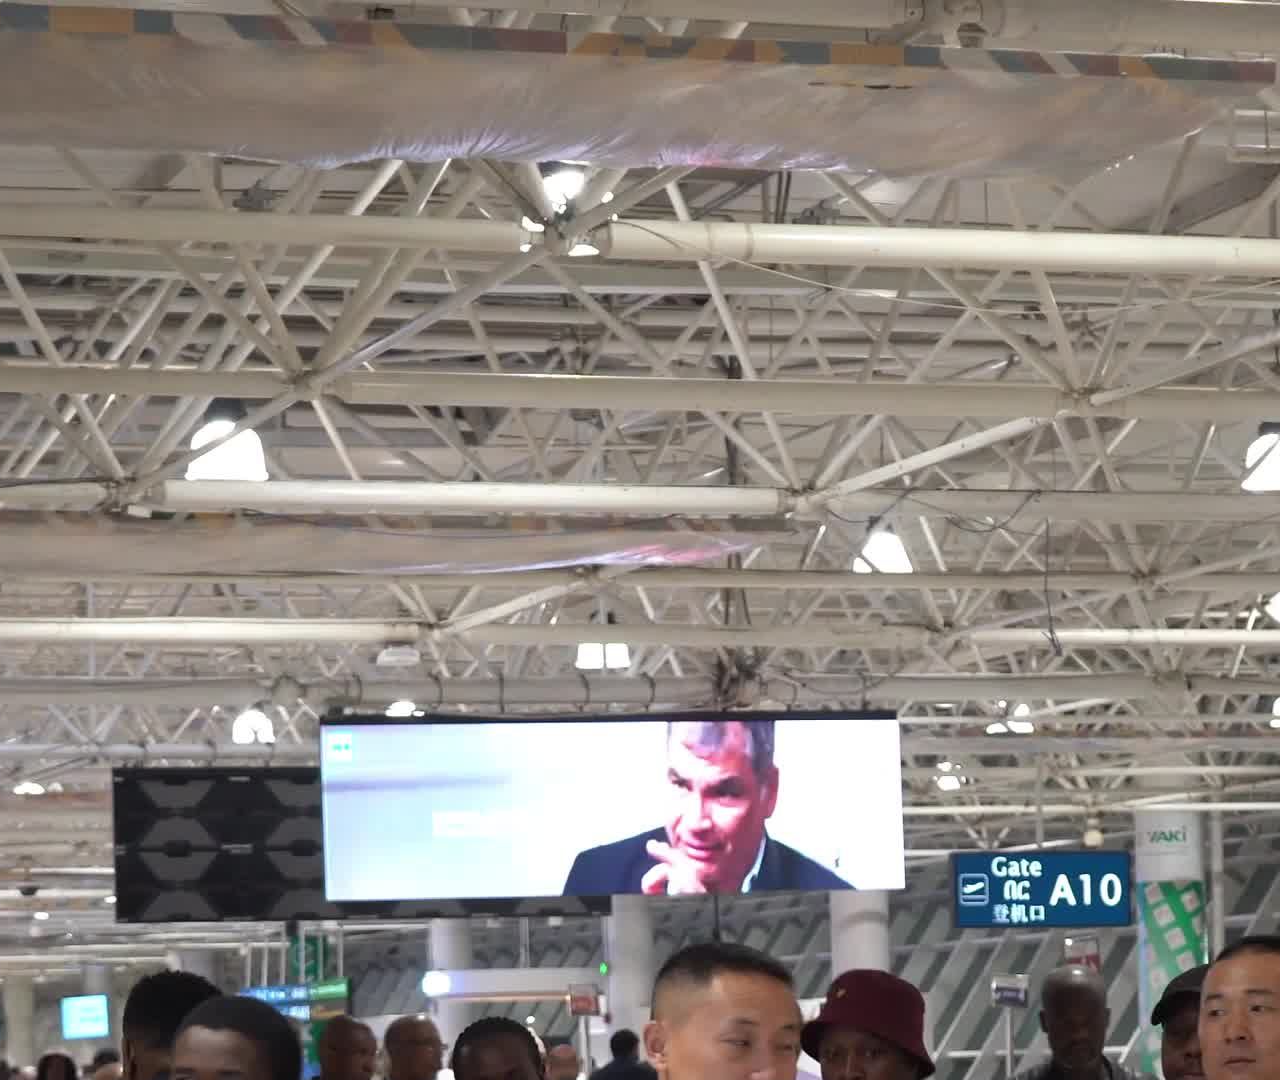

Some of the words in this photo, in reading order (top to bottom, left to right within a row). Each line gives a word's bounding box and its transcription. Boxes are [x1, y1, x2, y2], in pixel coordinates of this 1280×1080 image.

[991, 856, 1042, 877] Gate
[1049, 873, 1122, 906] A10
[992, 903, 1046, 923] 登机口
